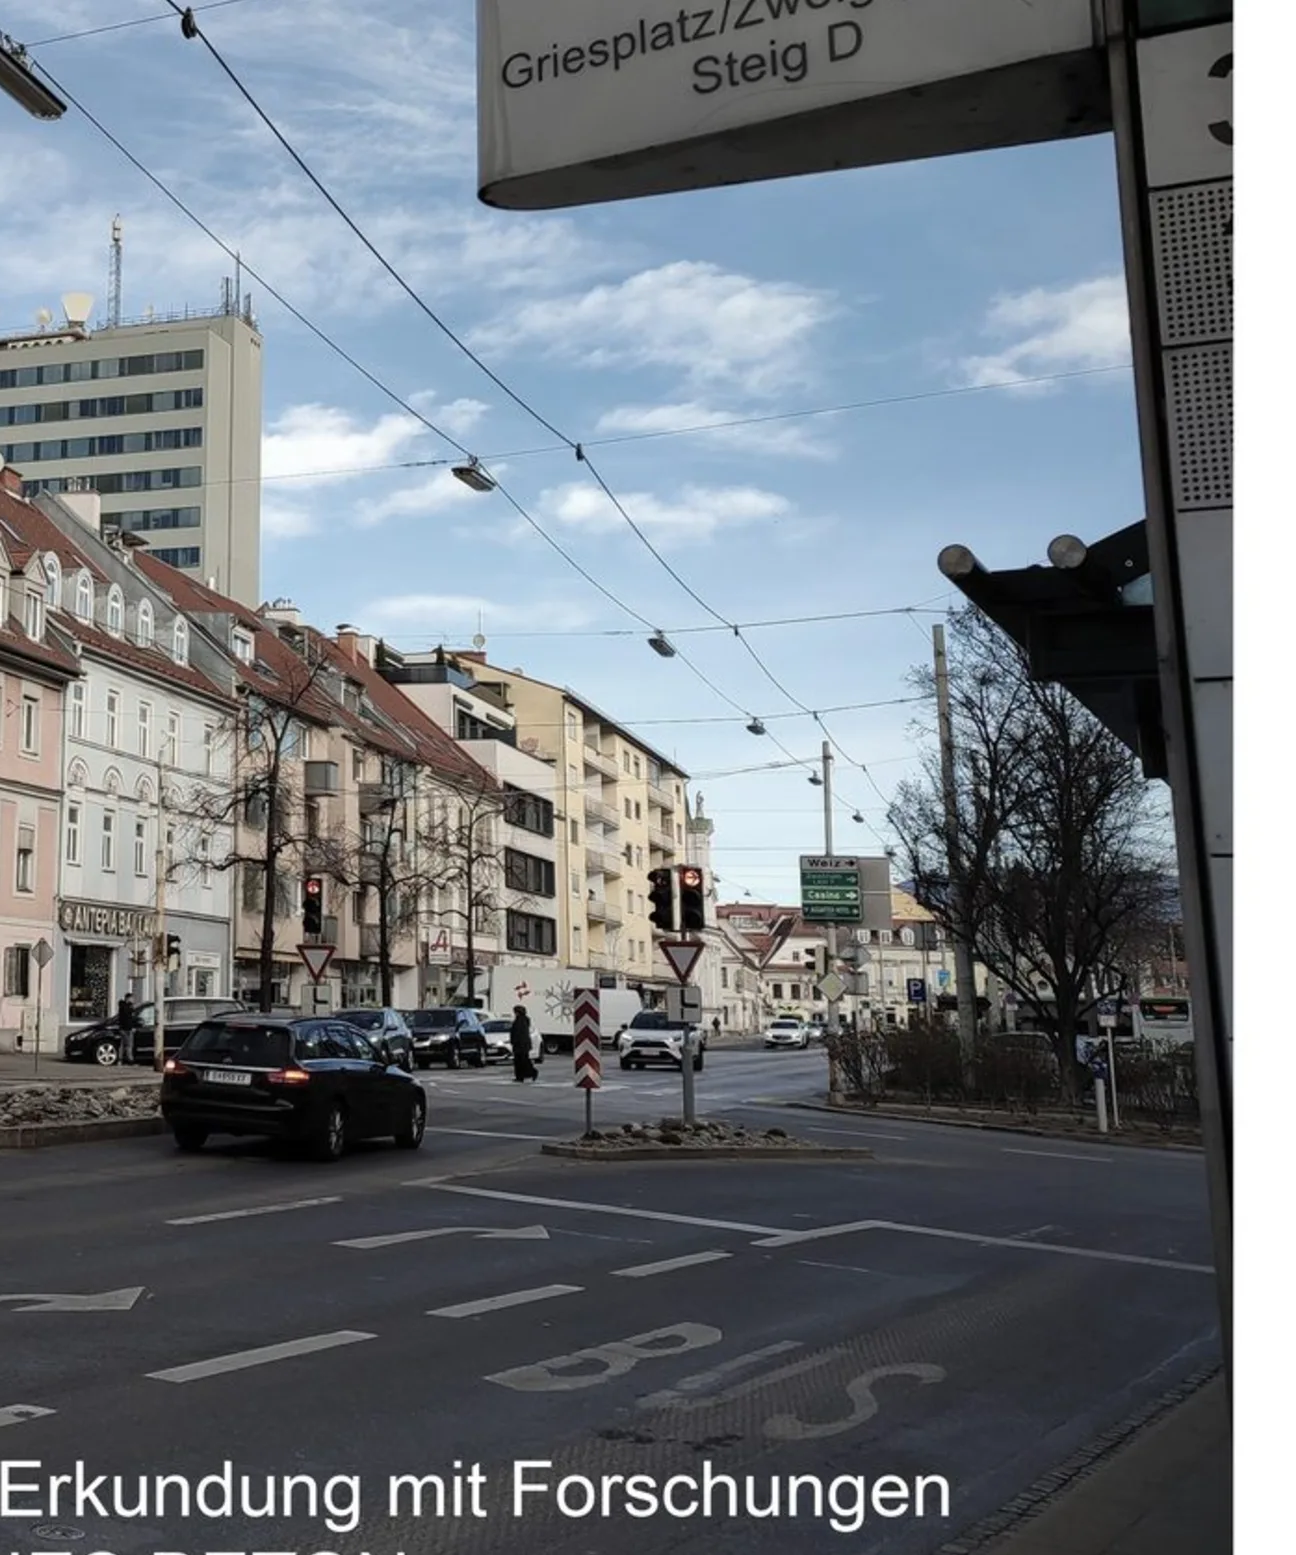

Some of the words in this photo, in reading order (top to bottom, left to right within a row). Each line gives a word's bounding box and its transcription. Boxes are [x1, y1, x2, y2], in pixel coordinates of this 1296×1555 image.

[691, 40, 809, 95] Steig
[827, 20, 864, 63] D
[807, 859, 840, 867] Weiz
[909, 980, 922, 997] P
